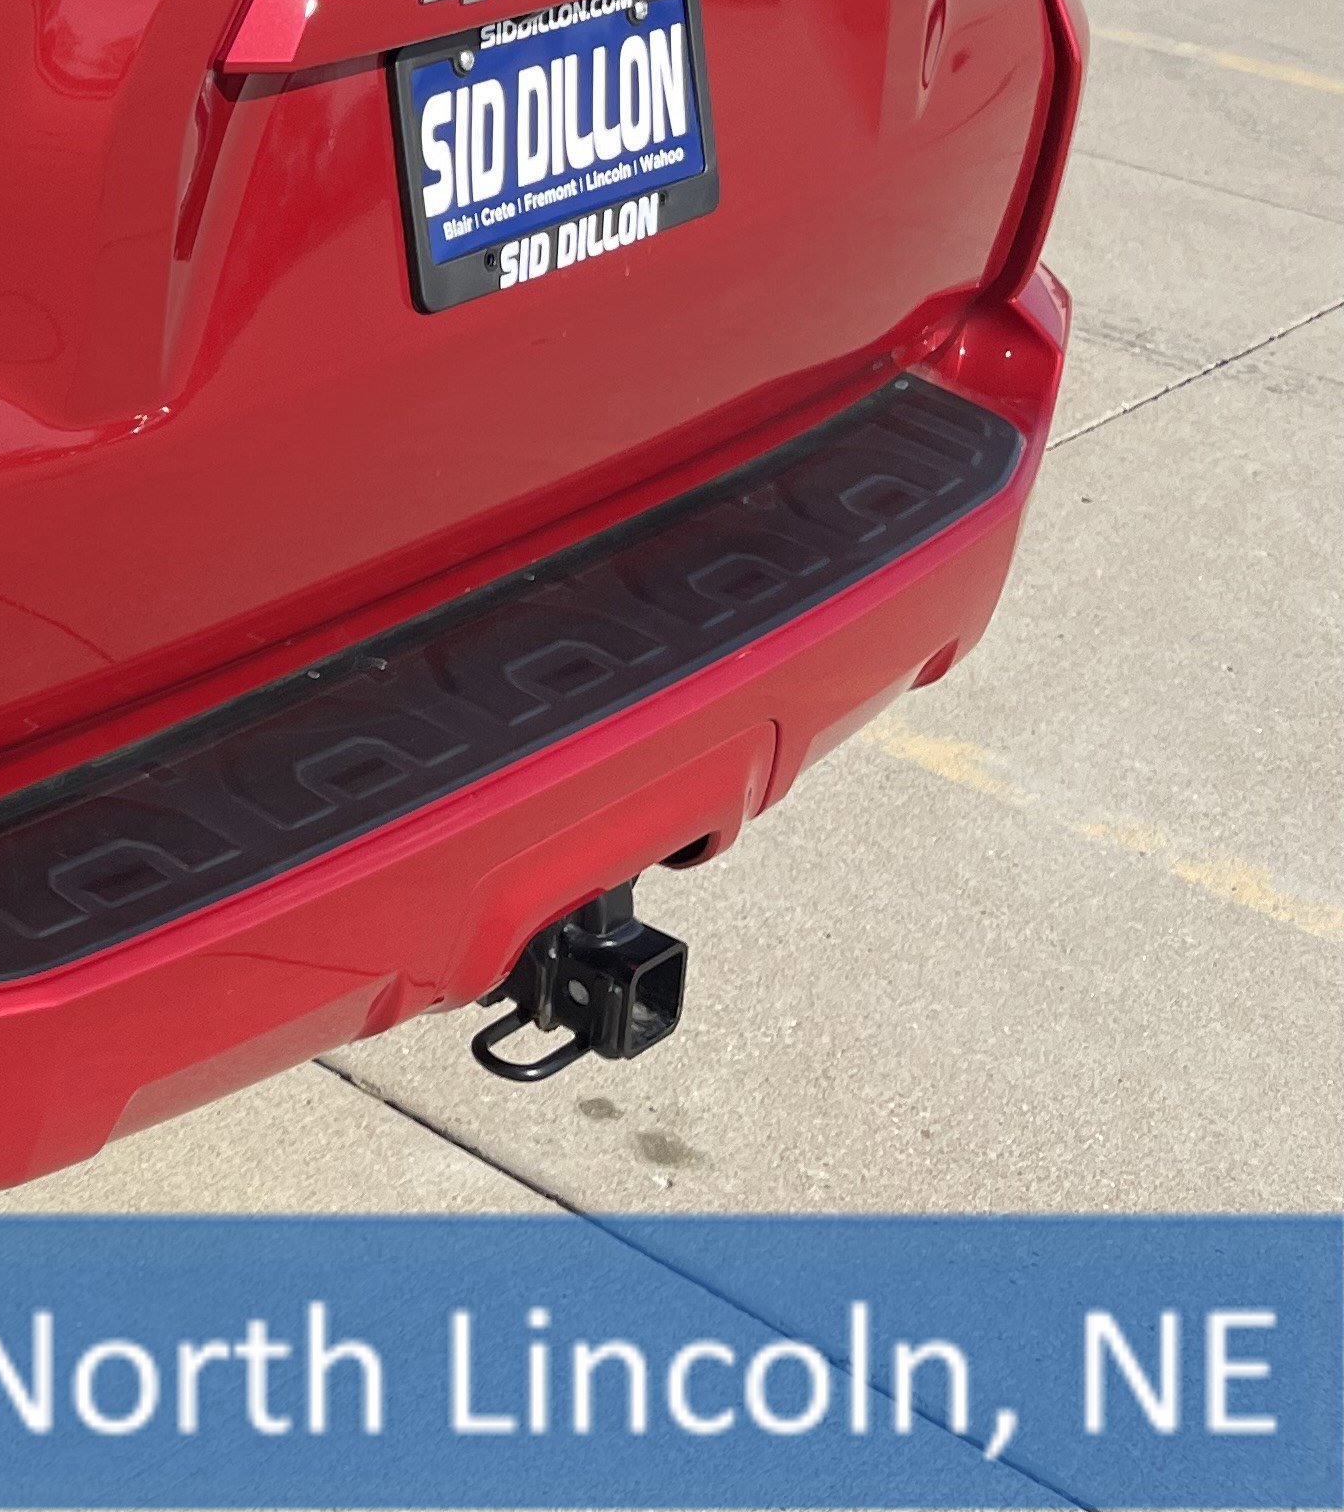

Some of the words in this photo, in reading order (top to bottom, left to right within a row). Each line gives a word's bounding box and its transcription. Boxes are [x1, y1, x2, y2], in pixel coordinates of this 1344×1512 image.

[421, 79, 506, 218] SID
[517, 23, 688, 187] DILLON
[443, 215, 473, 241] Blair
[481, 201, 516, 227] Crete
[524, 185, 578, 212] Fremont
[585, 162, 632, 192] Lincoln
[639, 146, 685, 174] Wahoo
[500, 232, 550, 289] SID
[557, 192, 660, 269] DILLON
